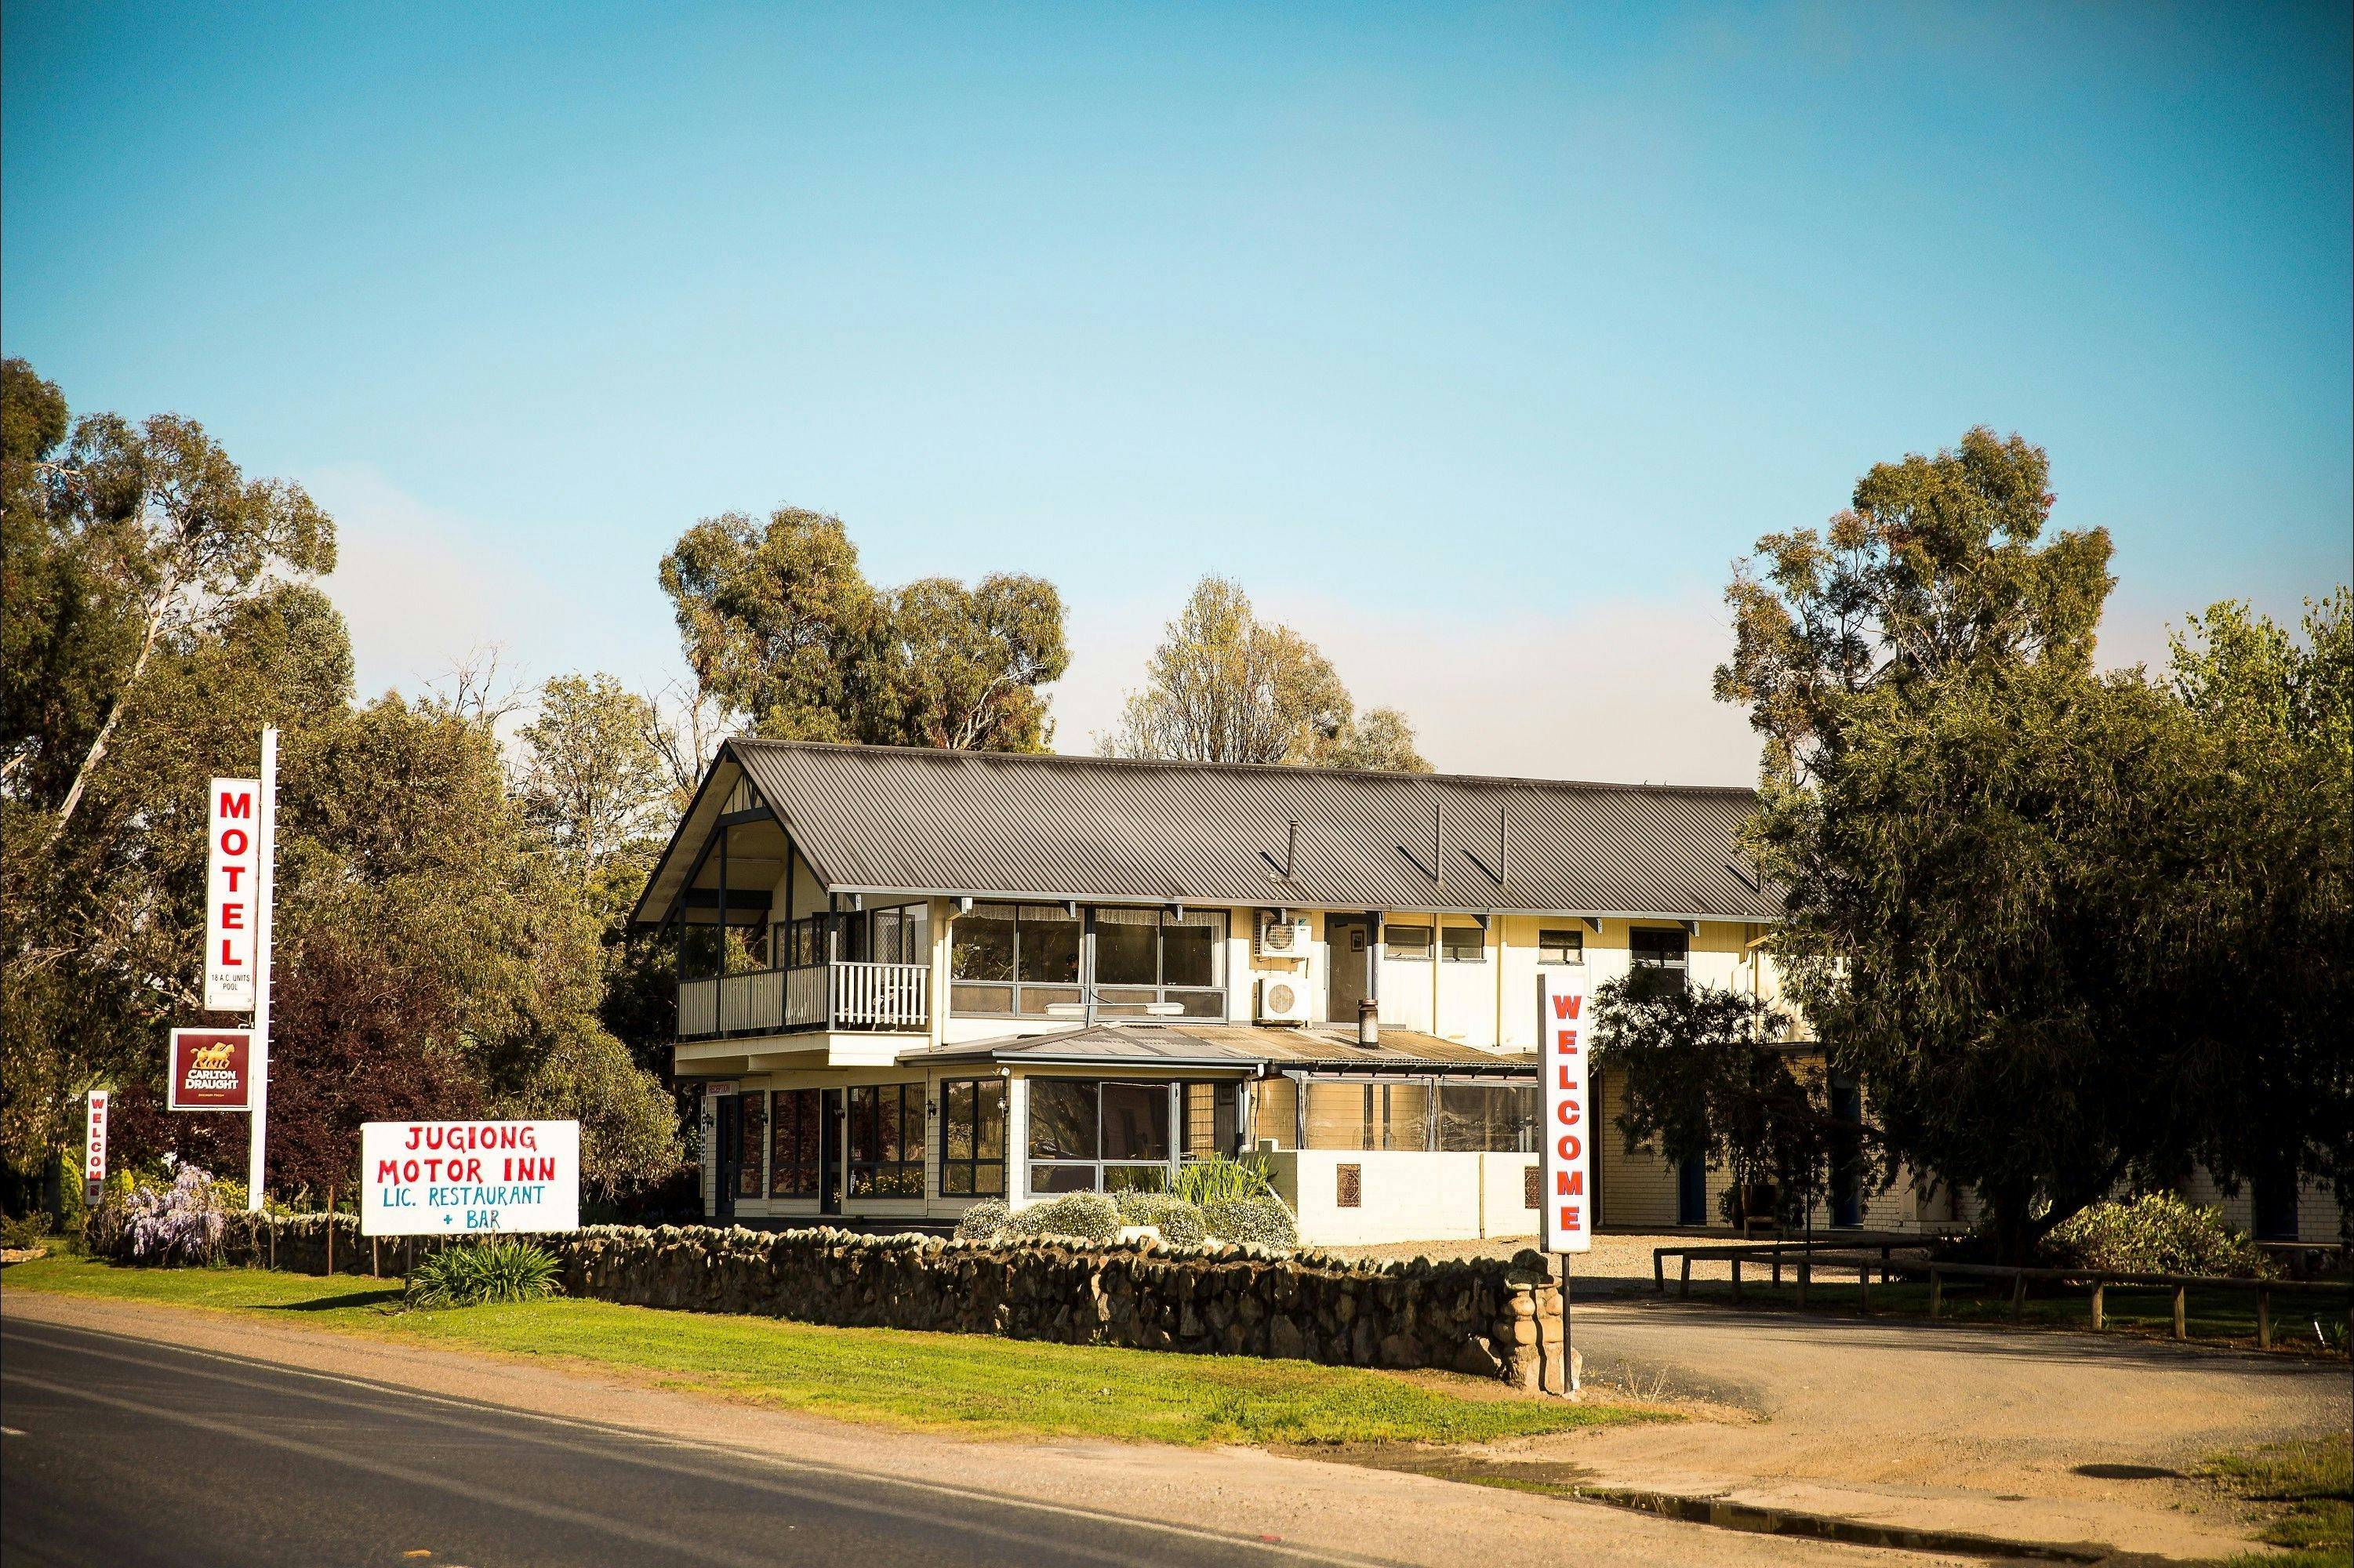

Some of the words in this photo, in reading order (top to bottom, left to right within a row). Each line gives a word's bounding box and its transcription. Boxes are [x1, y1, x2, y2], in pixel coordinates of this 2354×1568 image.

[220, 793, 251, 966] MOTEL
[232, 974, 250, 982] UNITS
[184, 1078, 239, 1090] DRAUGHT
[187, 1069, 237, 1080] CARLTON
[709, 1083, 731, 1094] RECEPTION
[1552, 994, 1583, 1231] WELCOME
[405, 1126, 537, 1154] JUGIONG
[376, 1158, 484, 1186] MOTOR
[503, 1156, 555, 1181] INN
[383, 1187, 416, 1207] LIC.
[428, 1185, 546, 1207] RESTAURANT
[466, 1210, 501, 1229] BAR
